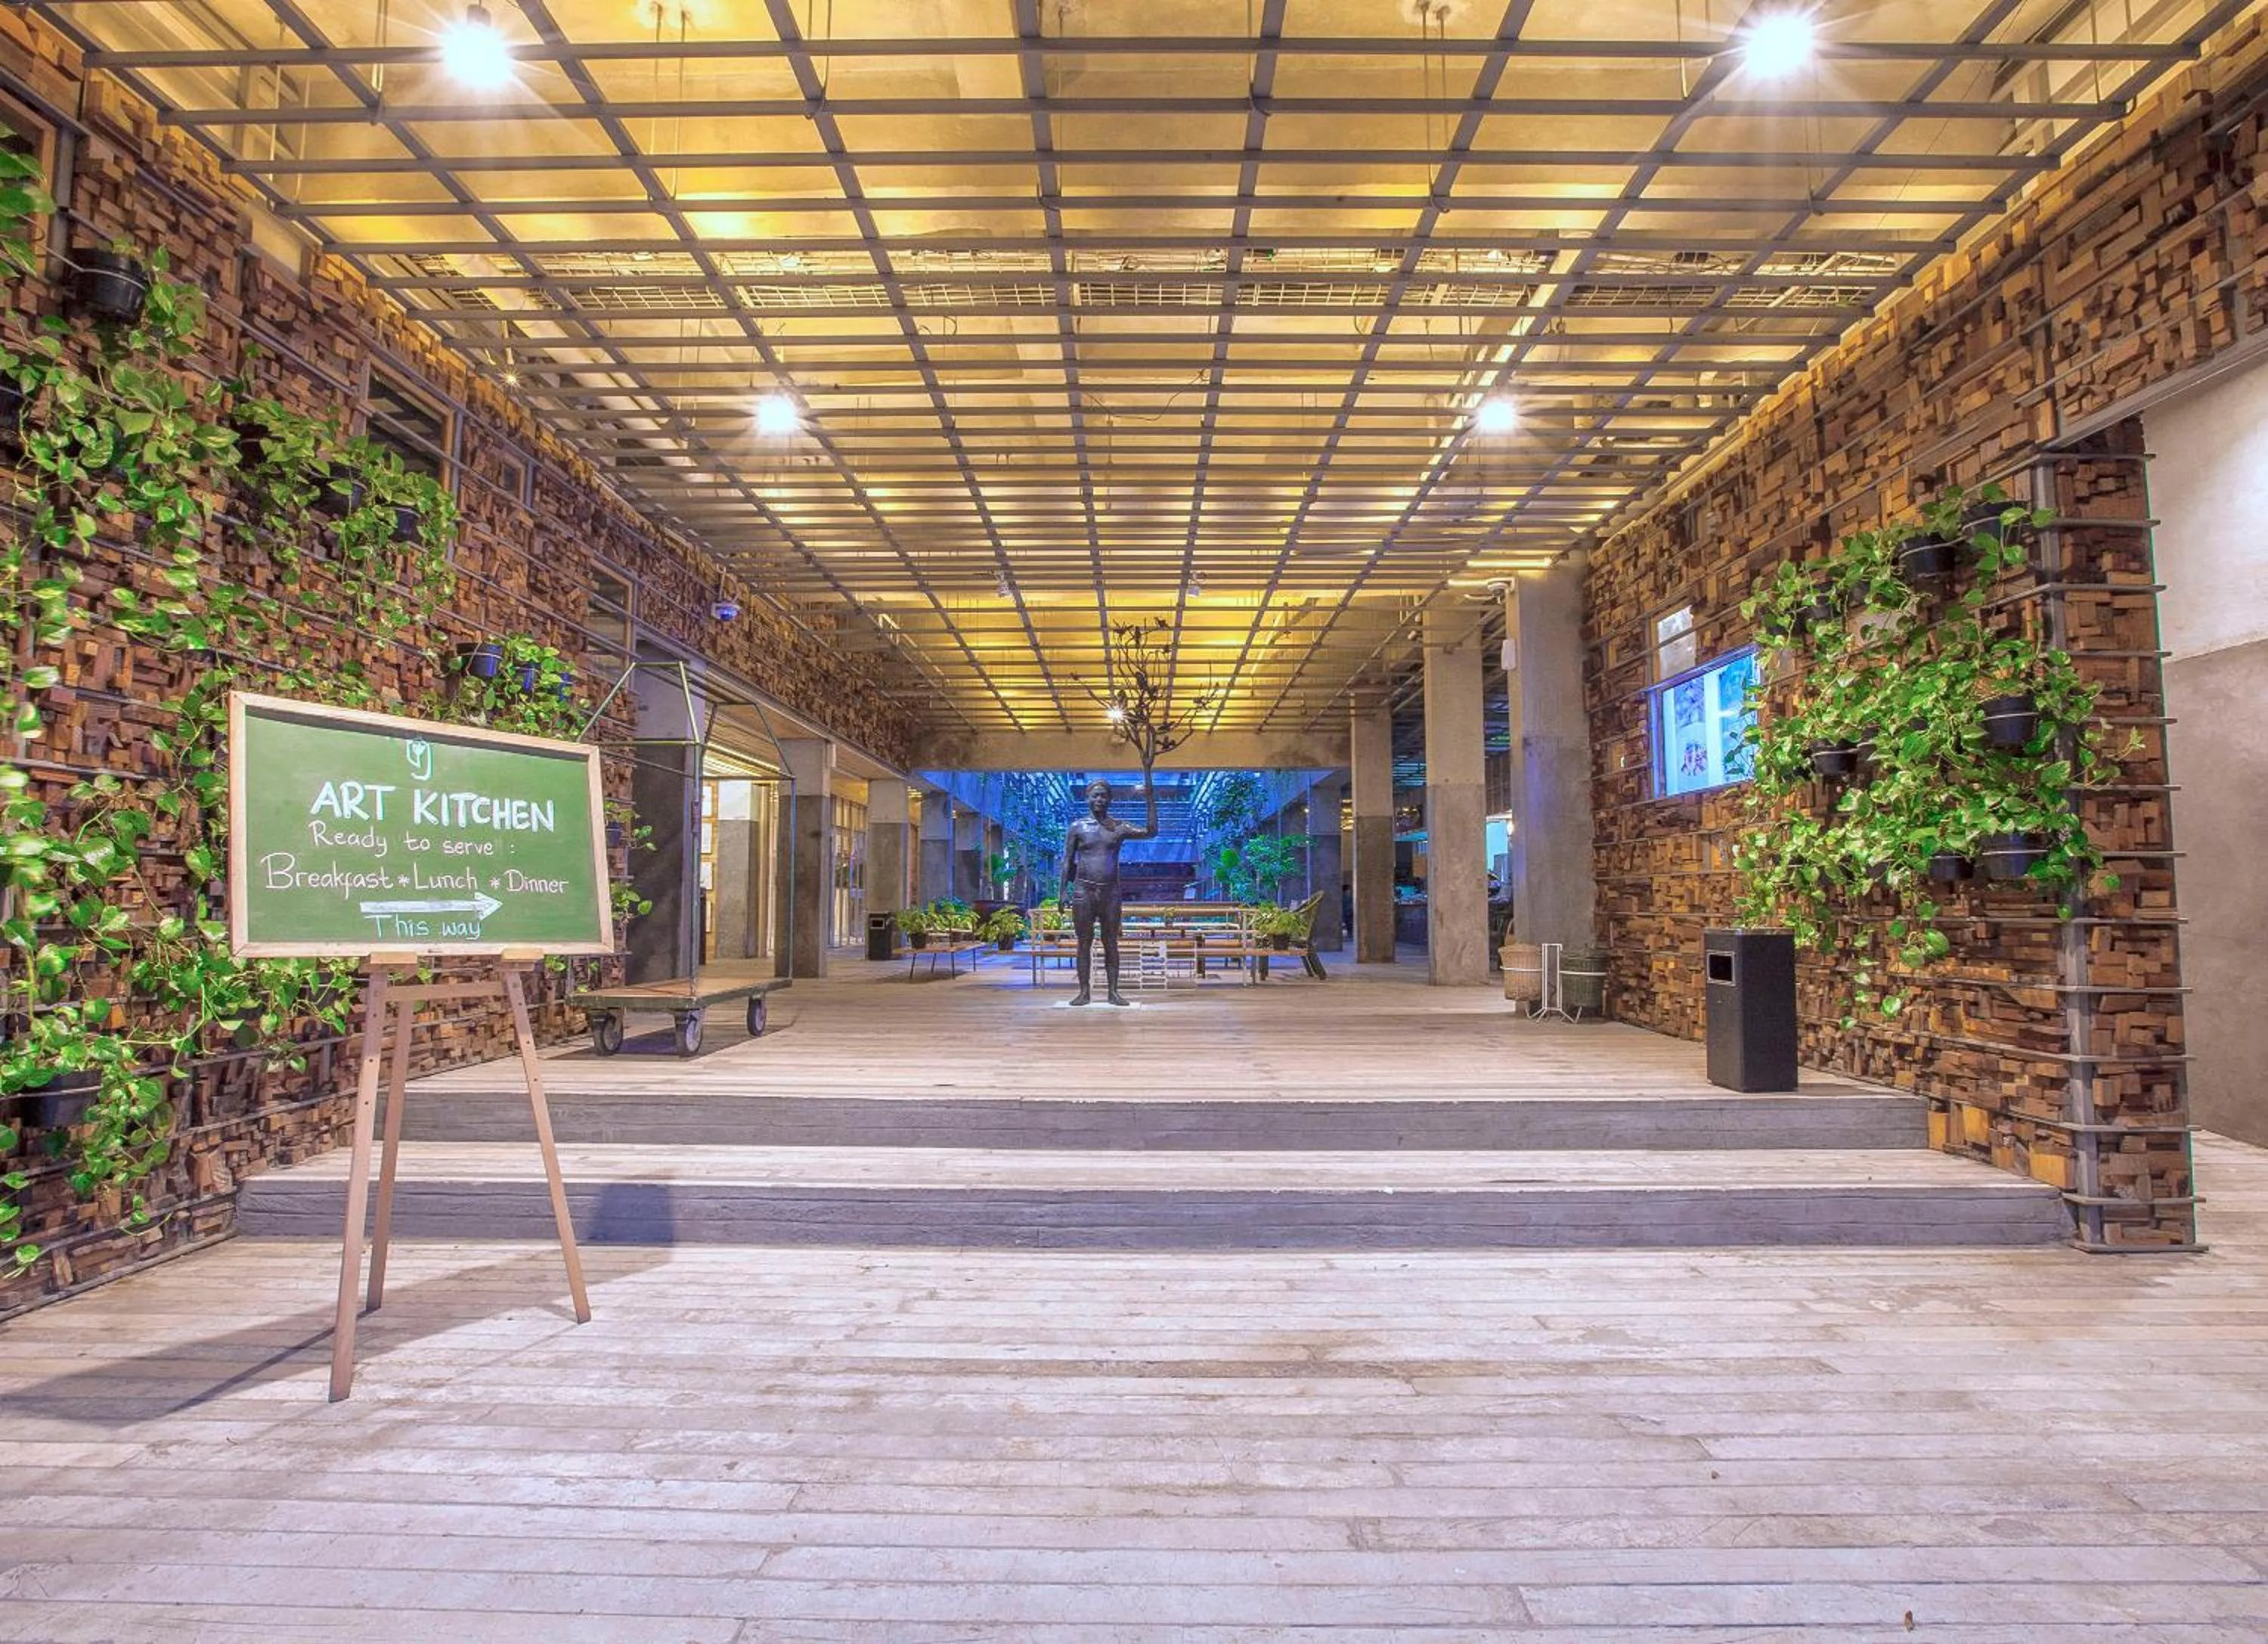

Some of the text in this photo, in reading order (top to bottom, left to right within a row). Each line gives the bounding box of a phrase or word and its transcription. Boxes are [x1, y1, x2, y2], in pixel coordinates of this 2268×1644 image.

[310, 781, 554, 833] ART KITCHEN
[308, 819, 388, 858] Ready
[403, 830, 431, 851] to
[442, 840, 494, 856] serve
[259, 851, 570, 900] Breakfast Lunch Dinner
[364, 913, 482, 940] This way
